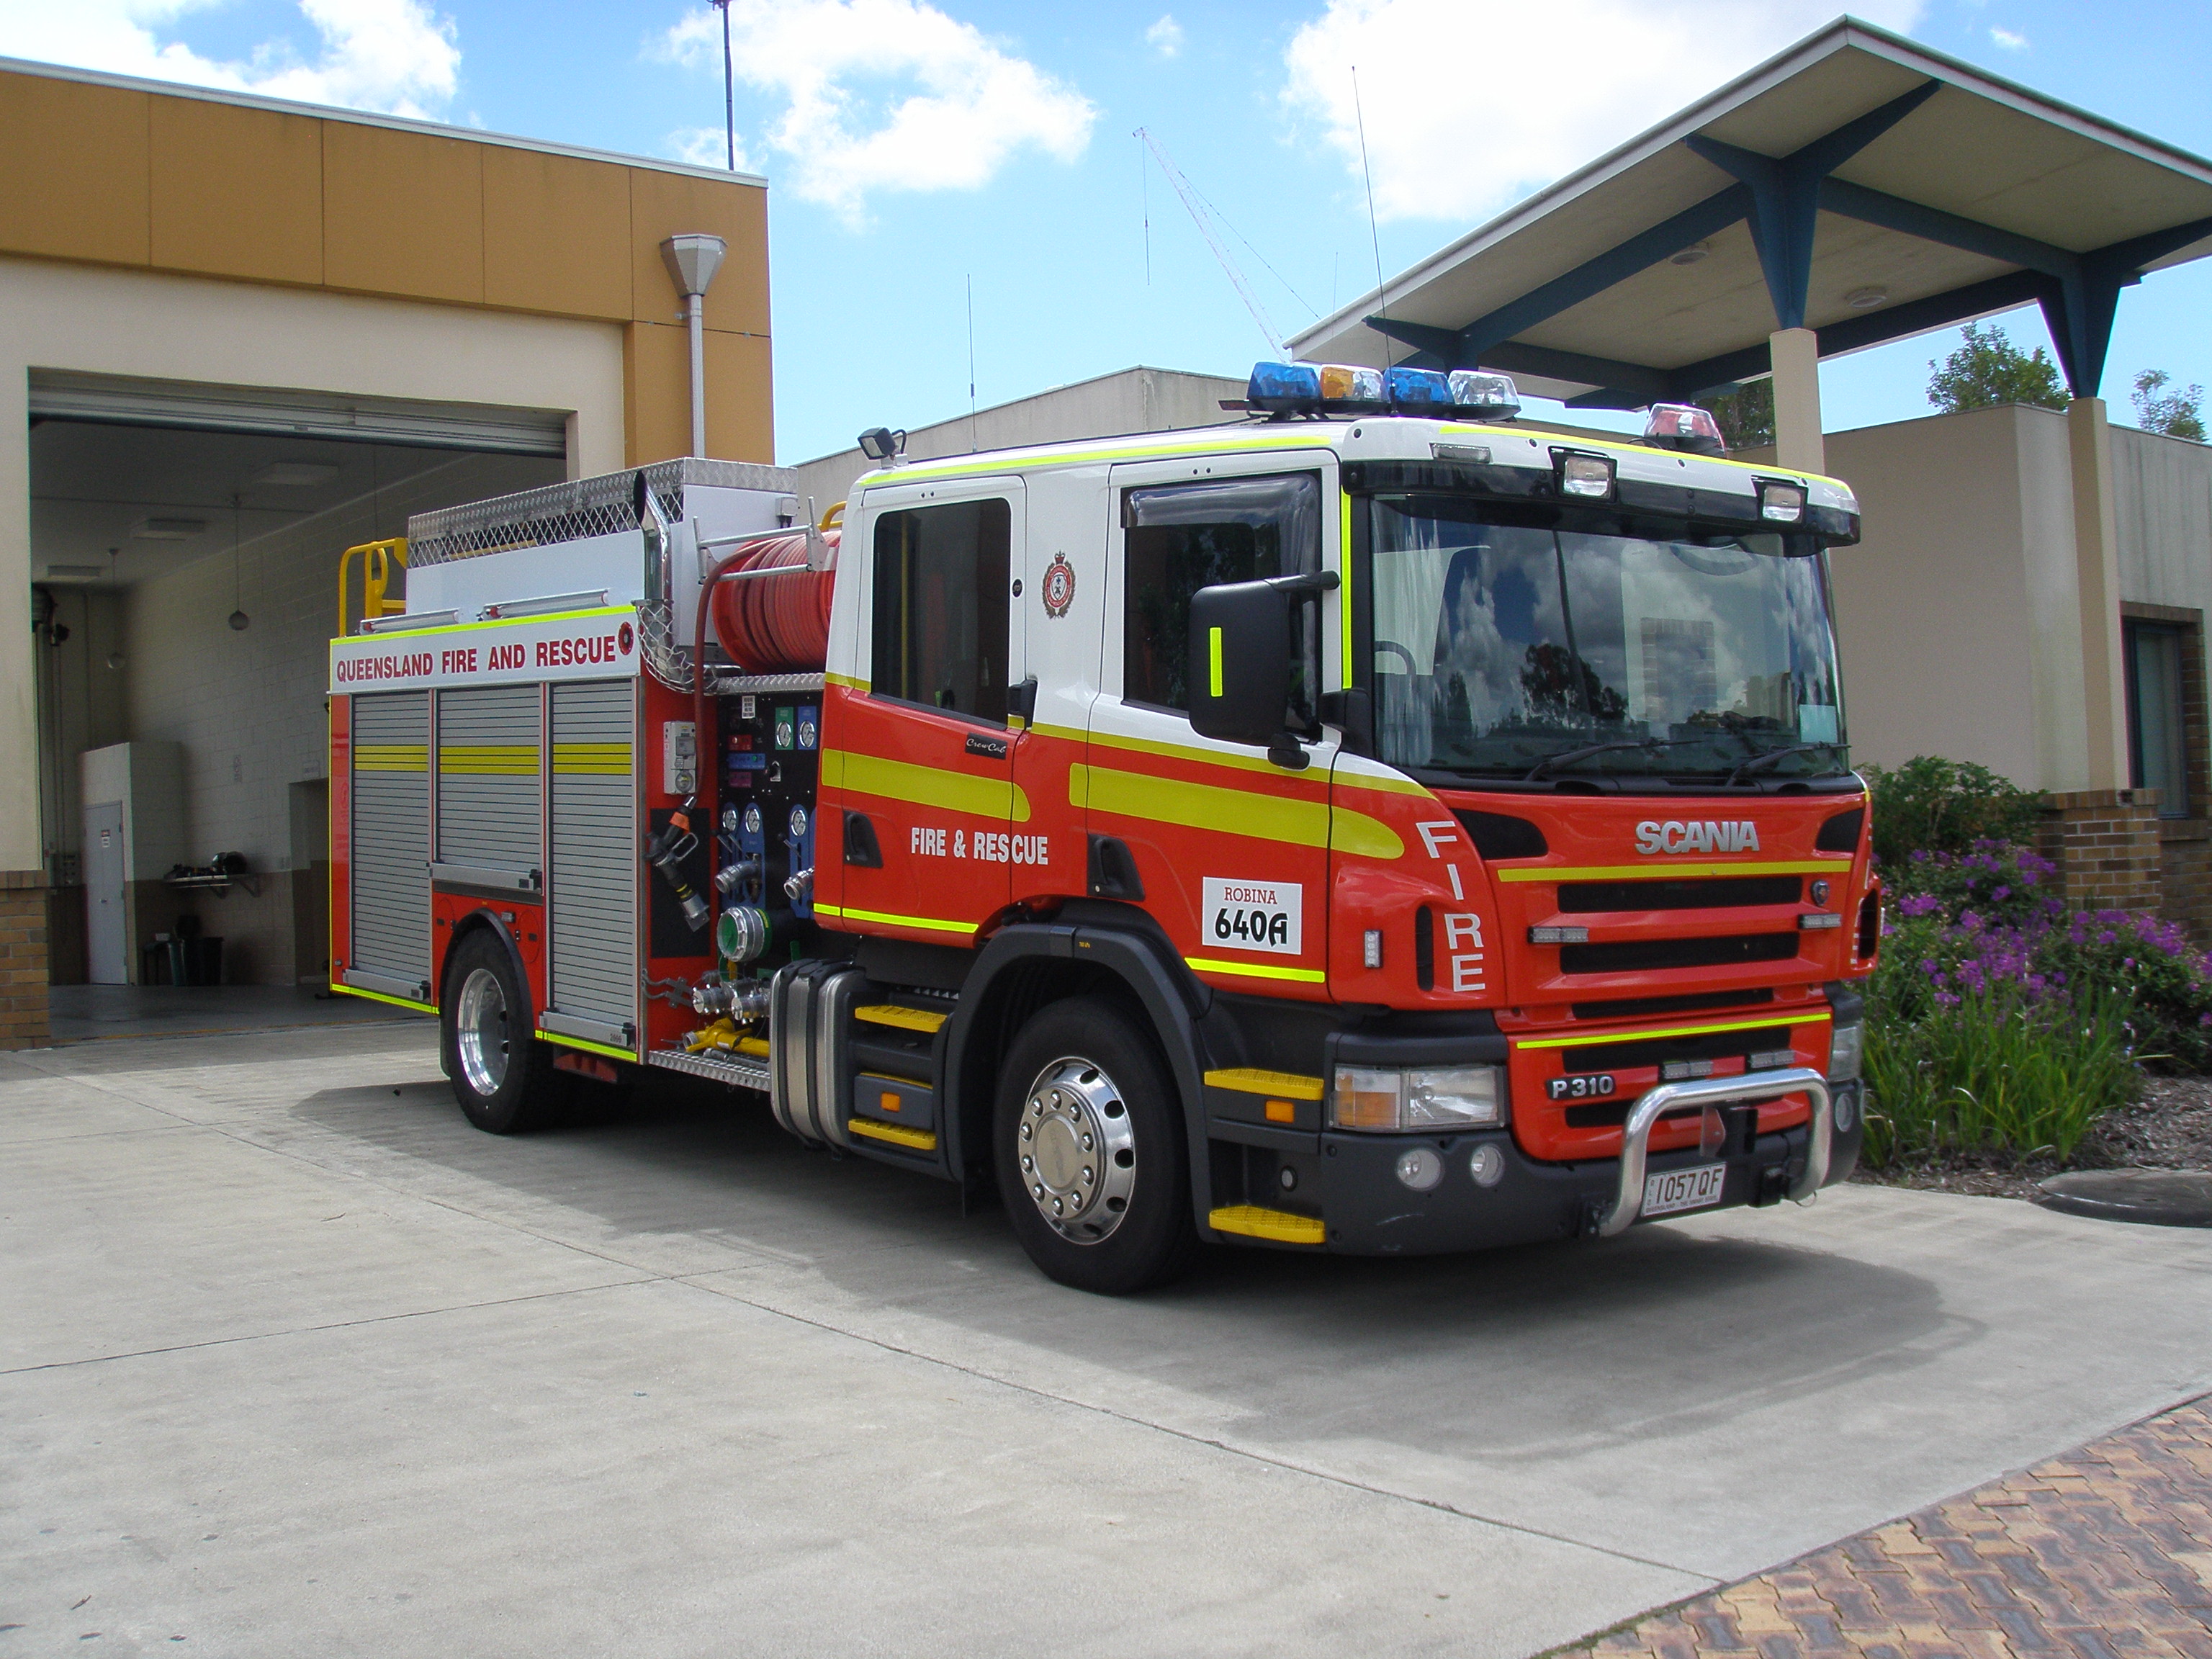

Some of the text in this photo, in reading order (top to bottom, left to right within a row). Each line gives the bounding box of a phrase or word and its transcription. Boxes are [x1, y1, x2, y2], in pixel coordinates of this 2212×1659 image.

[337, 635, 616, 683] QUEENSLAND FIRE AND RESCUE
[911, 827, 1048, 865] FIRE & RESCUE
[1635, 821, 1760, 855] SCANIA
[1224, 886, 1277, 905] ROBINA
[1416, 820, 1485, 992] FIRE
[1215, 908, 1287, 947] 640A
